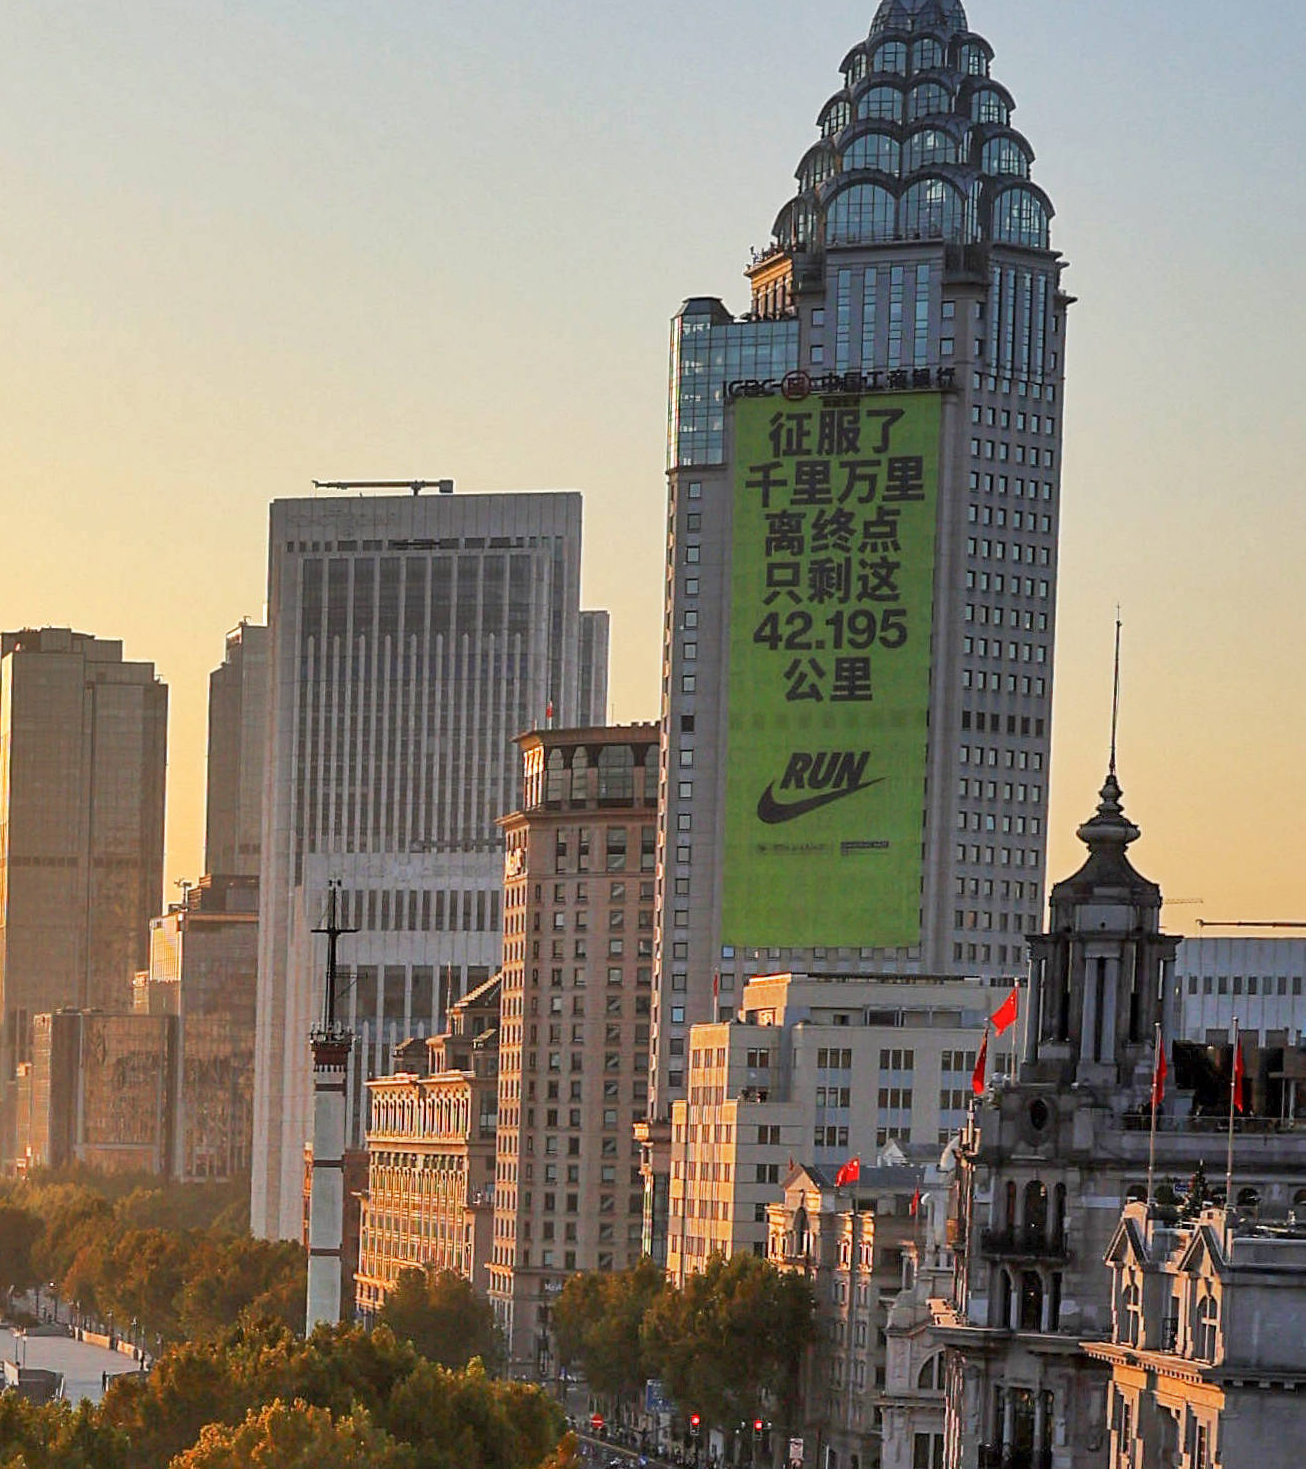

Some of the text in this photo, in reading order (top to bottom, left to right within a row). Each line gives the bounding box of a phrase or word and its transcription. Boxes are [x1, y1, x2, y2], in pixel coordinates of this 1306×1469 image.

[769, 408, 905, 458] 征服了
[745, 456, 925, 508] 千里万里
[764, 506, 900, 557] 离终点
[762, 557, 900, 605] 只剩这
[753, 609, 908, 651] 42.195
[783, 657, 872, 703] 公里
[781, 751, 870, 791] RUN
